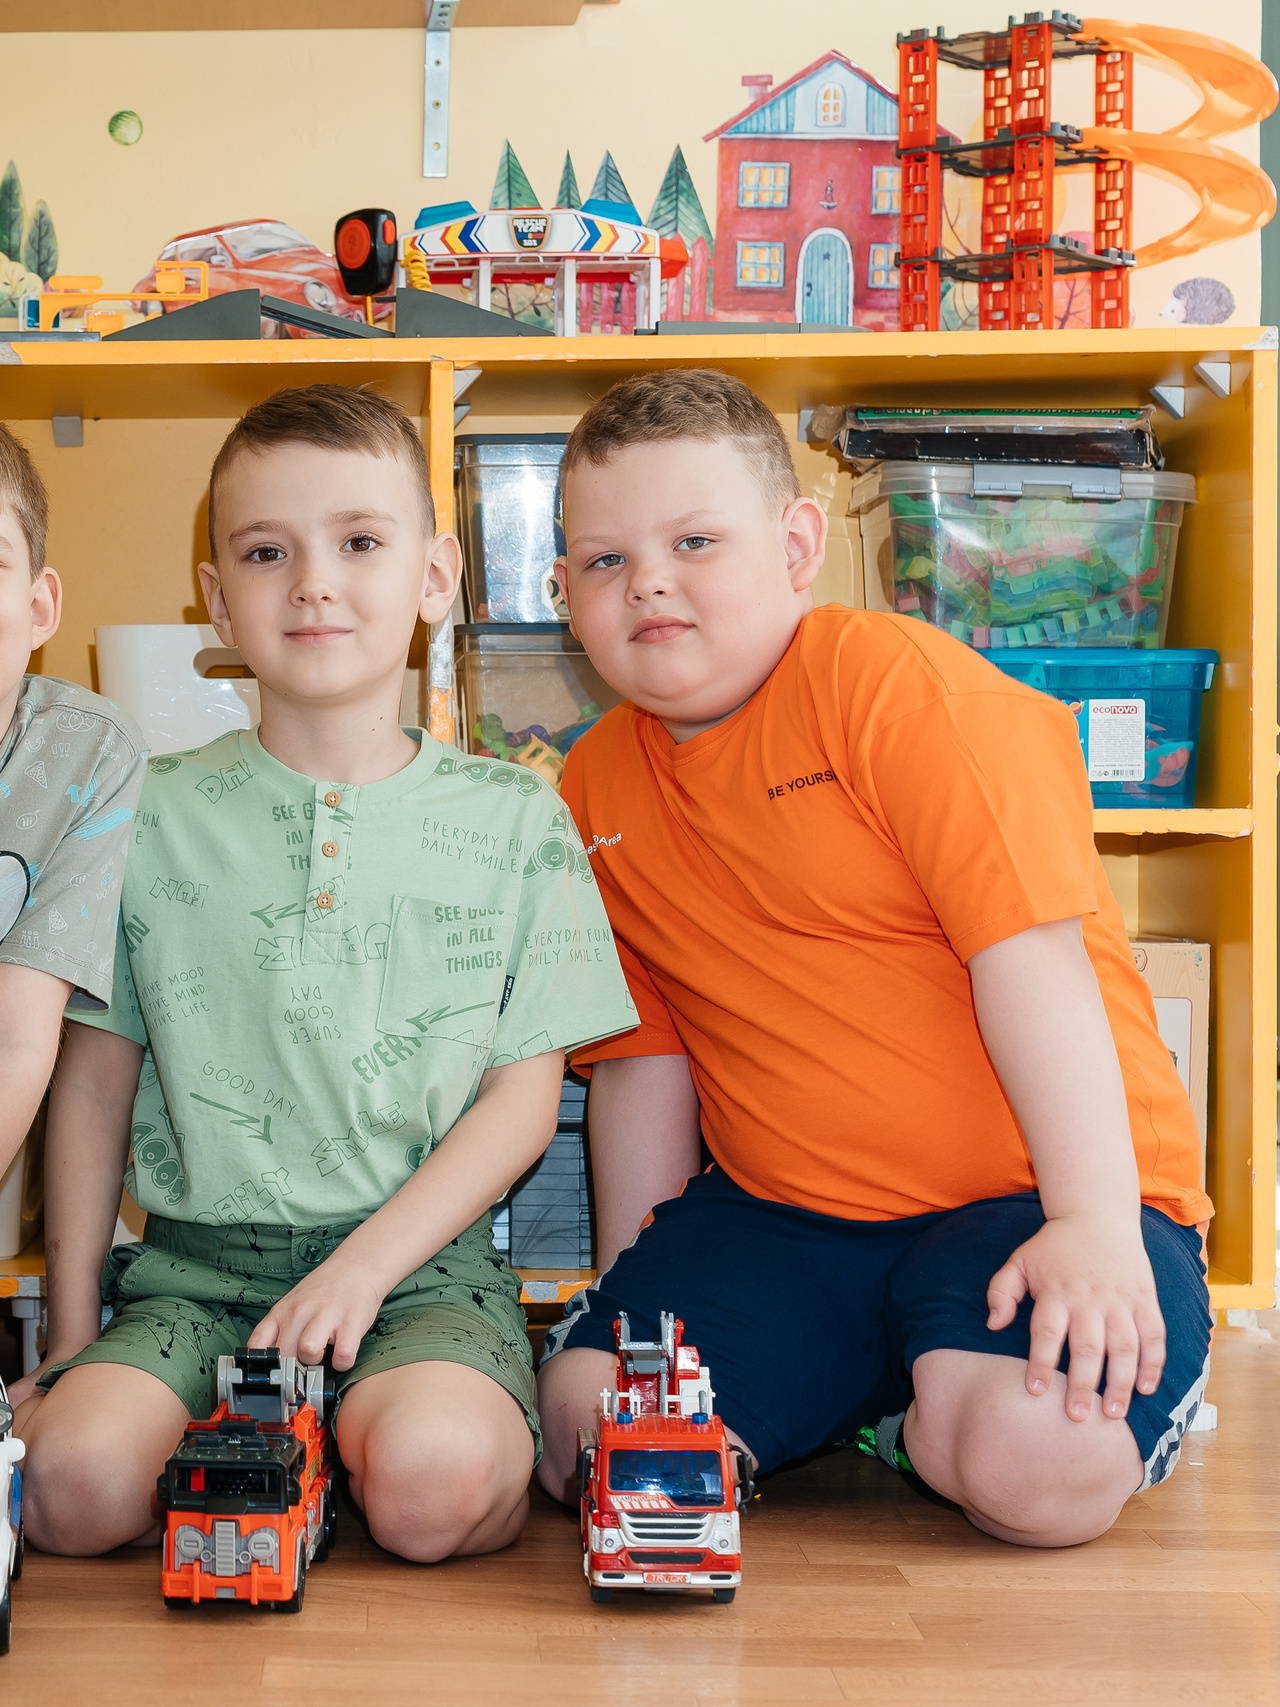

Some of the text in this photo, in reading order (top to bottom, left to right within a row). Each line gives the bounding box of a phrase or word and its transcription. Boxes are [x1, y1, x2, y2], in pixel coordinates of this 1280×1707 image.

[1092, 705, 1138, 715] econova
[767, 785, 785, 800] BE
[271, 803, 298, 822] SEE
[422, 817, 524, 853] EVERYDAY FU
[421, 836, 519, 873] DAILY SMILE
[434, 904, 462, 922] SEE
[469, 926, 496, 945] ALL
[586, 927, 612, 944] FUN
[569, 948, 605, 964] SMILE
[167, 966, 205, 986] MOOD
[175, 983, 207, 1002] MIND
[290, 985, 323, 1003] DAY
[181, 1000, 211, 1019] LIFE
[284, 1005, 334, 1025] GOOD
[288, 1025, 342, 1044] SUPER
[202, 1060, 297, 1118] GOOD DAY
[651, 1573, 684, 1583] TRUCK
